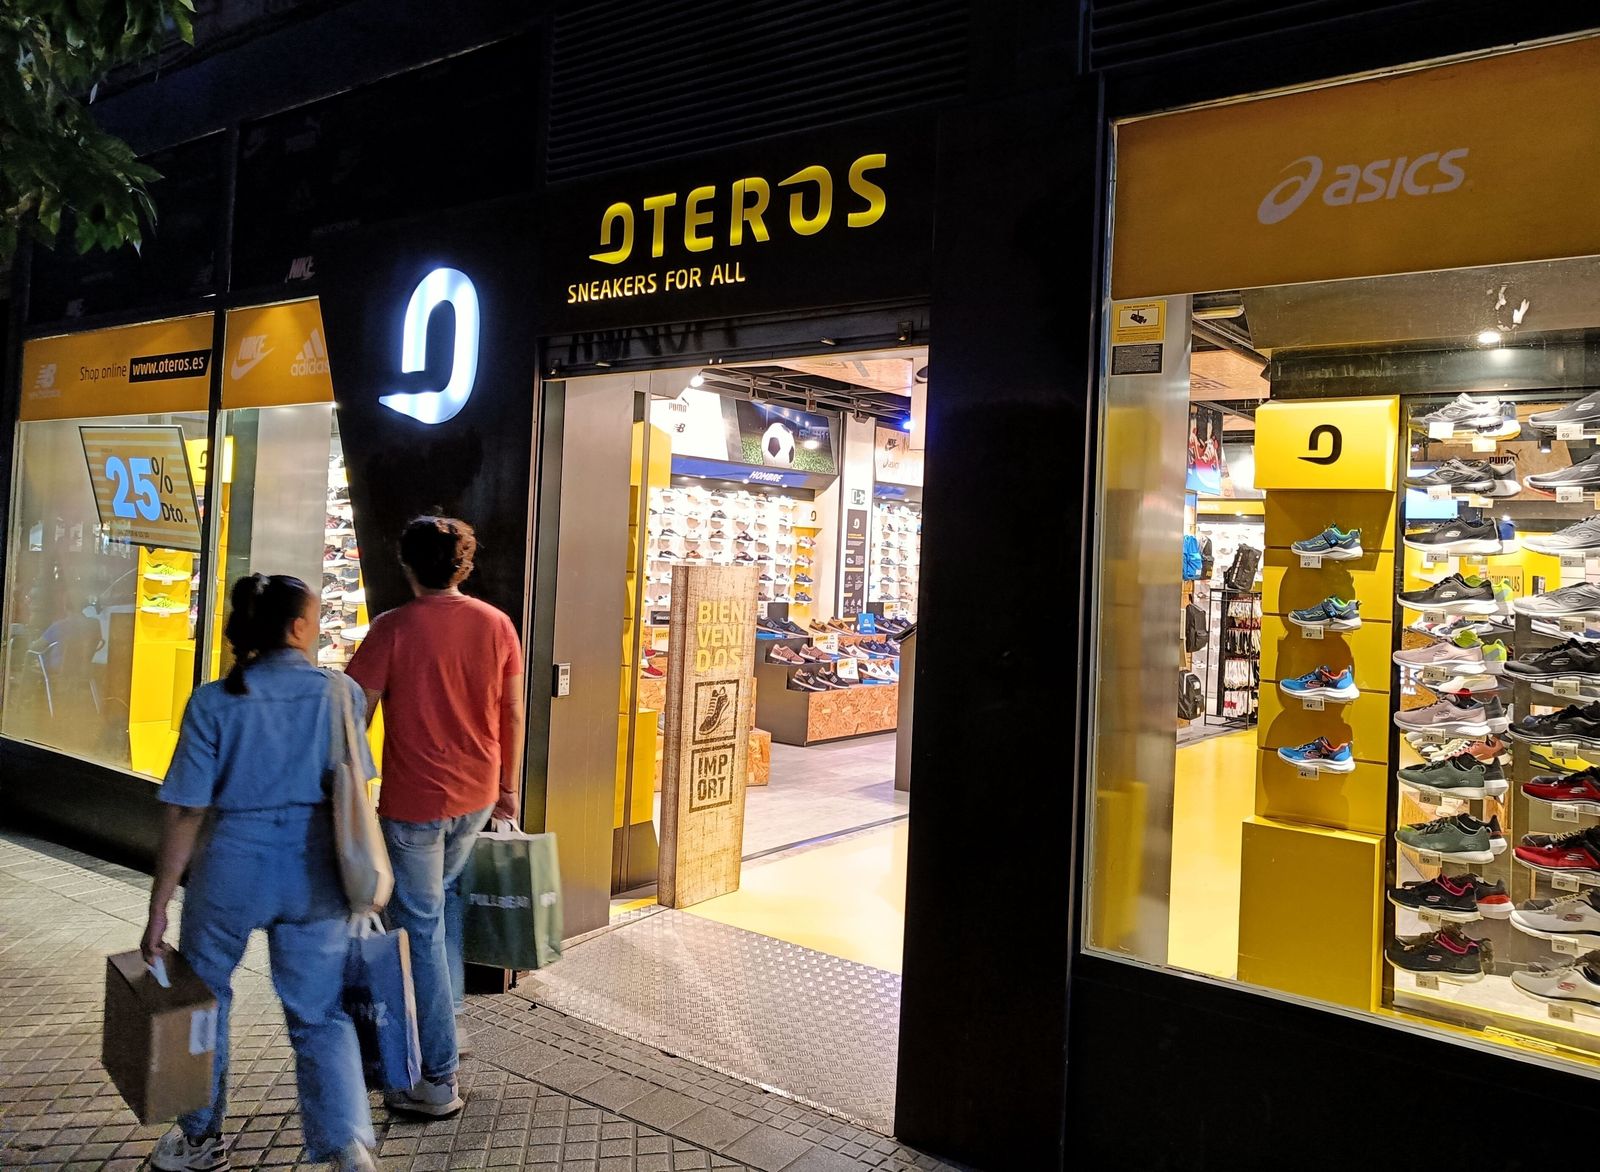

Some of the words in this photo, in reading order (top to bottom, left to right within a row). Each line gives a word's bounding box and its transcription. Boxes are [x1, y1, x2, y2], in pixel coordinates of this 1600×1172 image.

[1322, 147, 1469, 206] asics
[589, 153, 887, 264] OTEROS
[288, 256, 314, 279] NIKE
[567, 273, 657, 304] SNEAKERS
[665, 267, 702, 292] FOR
[710, 261, 746, 286] ALL
[238, 335, 270, 361] NIKE
[80, 366, 99, 383] Shop
[101, 363, 127, 378] online
[132, 356, 204, 377] www.oteros.es
[668, 402, 687, 413] PUMA
[749, 470, 784, 482] HOMBRE
[160, 502, 188, 523] Dto.
[698, 600, 745, 624] BIEN
[697, 624, 744, 648] VENI
[695, 647, 743, 673] DOS
[697, 754, 728, 778] IMP
[697, 776, 727, 801] ORT
